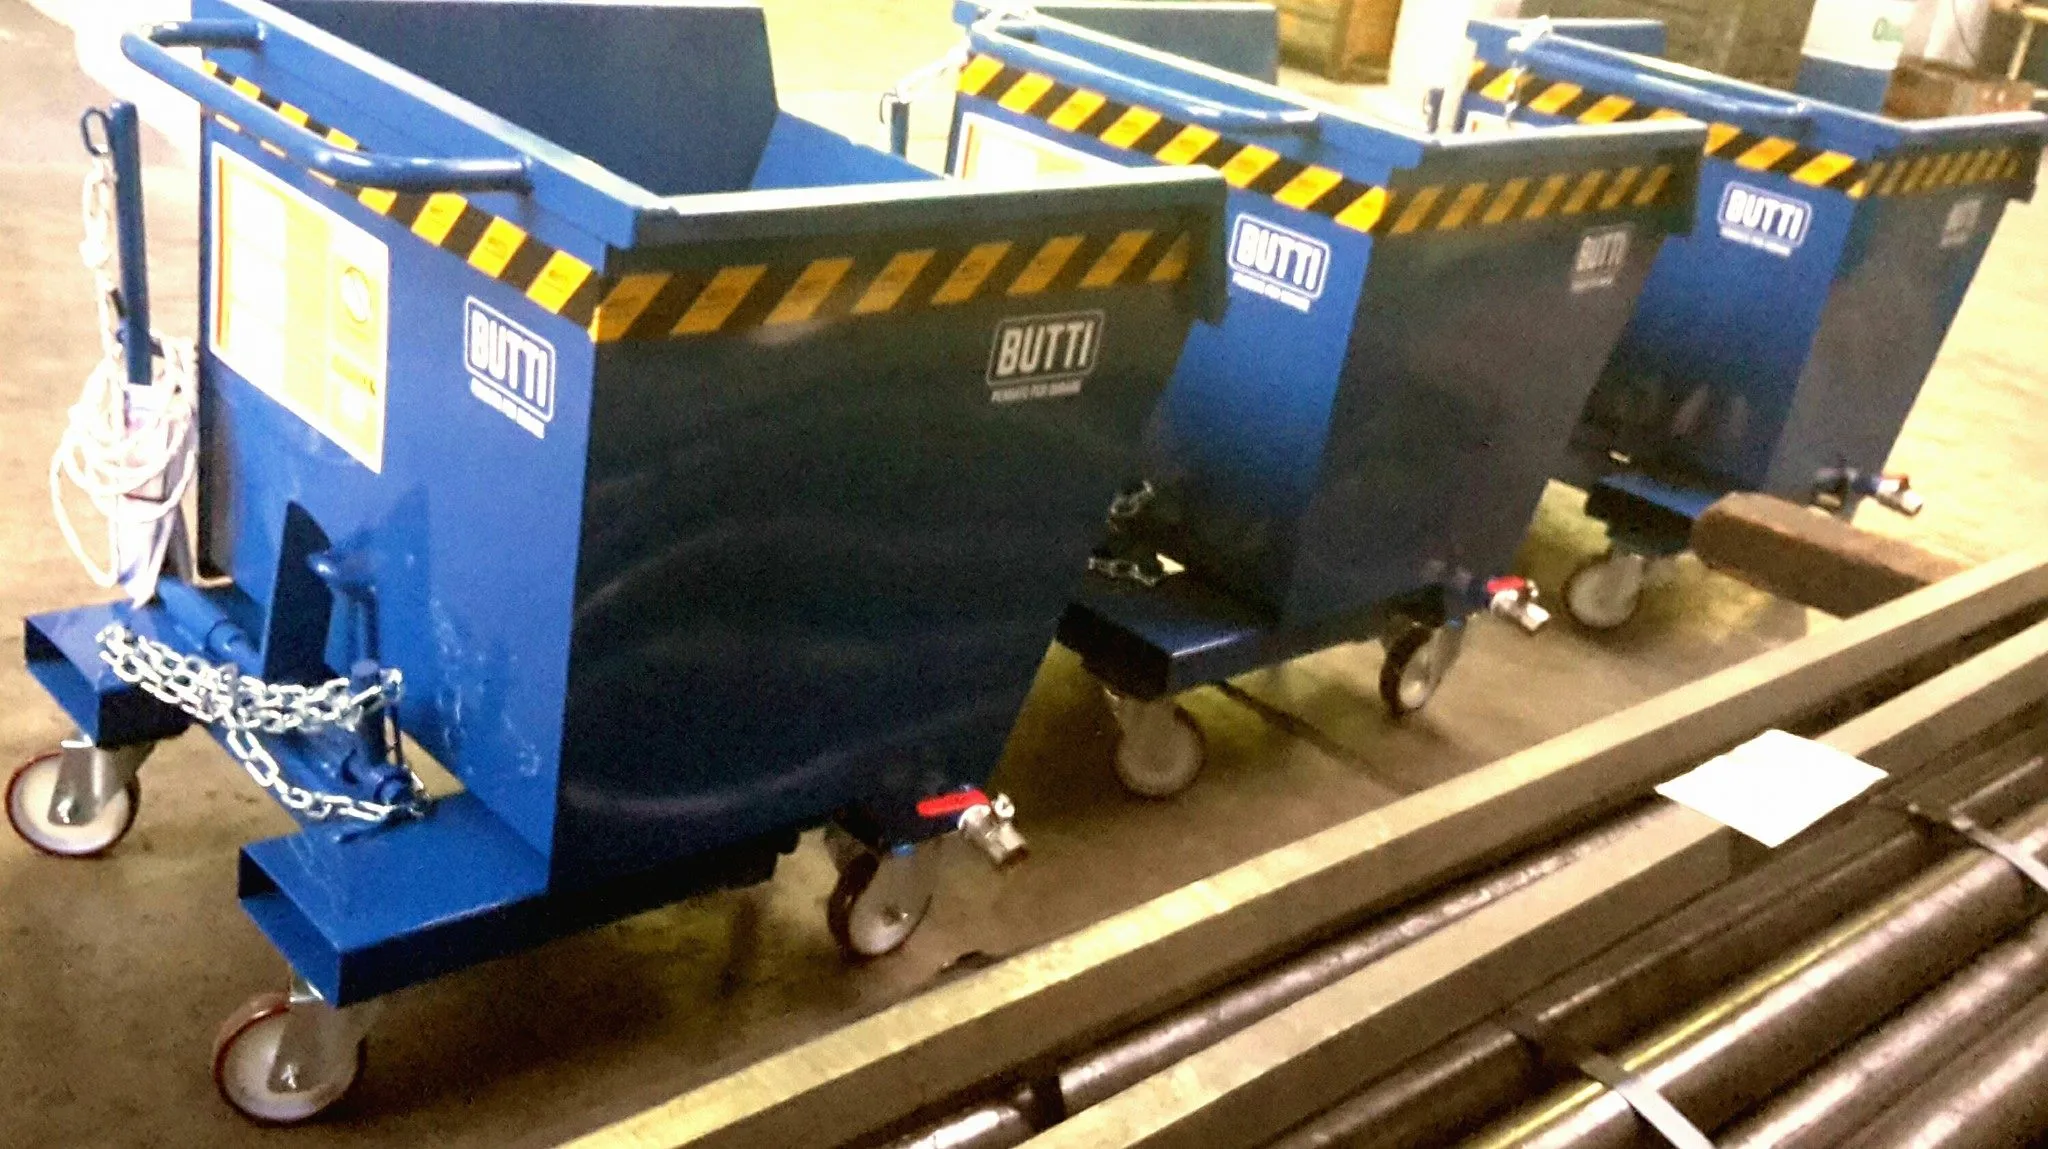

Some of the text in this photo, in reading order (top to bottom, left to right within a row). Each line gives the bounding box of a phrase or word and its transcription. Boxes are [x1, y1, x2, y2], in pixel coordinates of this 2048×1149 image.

[1725, 189, 1804, 240] BUTTI
[1237, 222, 1321, 291] BUTTI
[471, 309, 548, 408] BUTTI
[995, 321, 1096, 376] BUTTI
